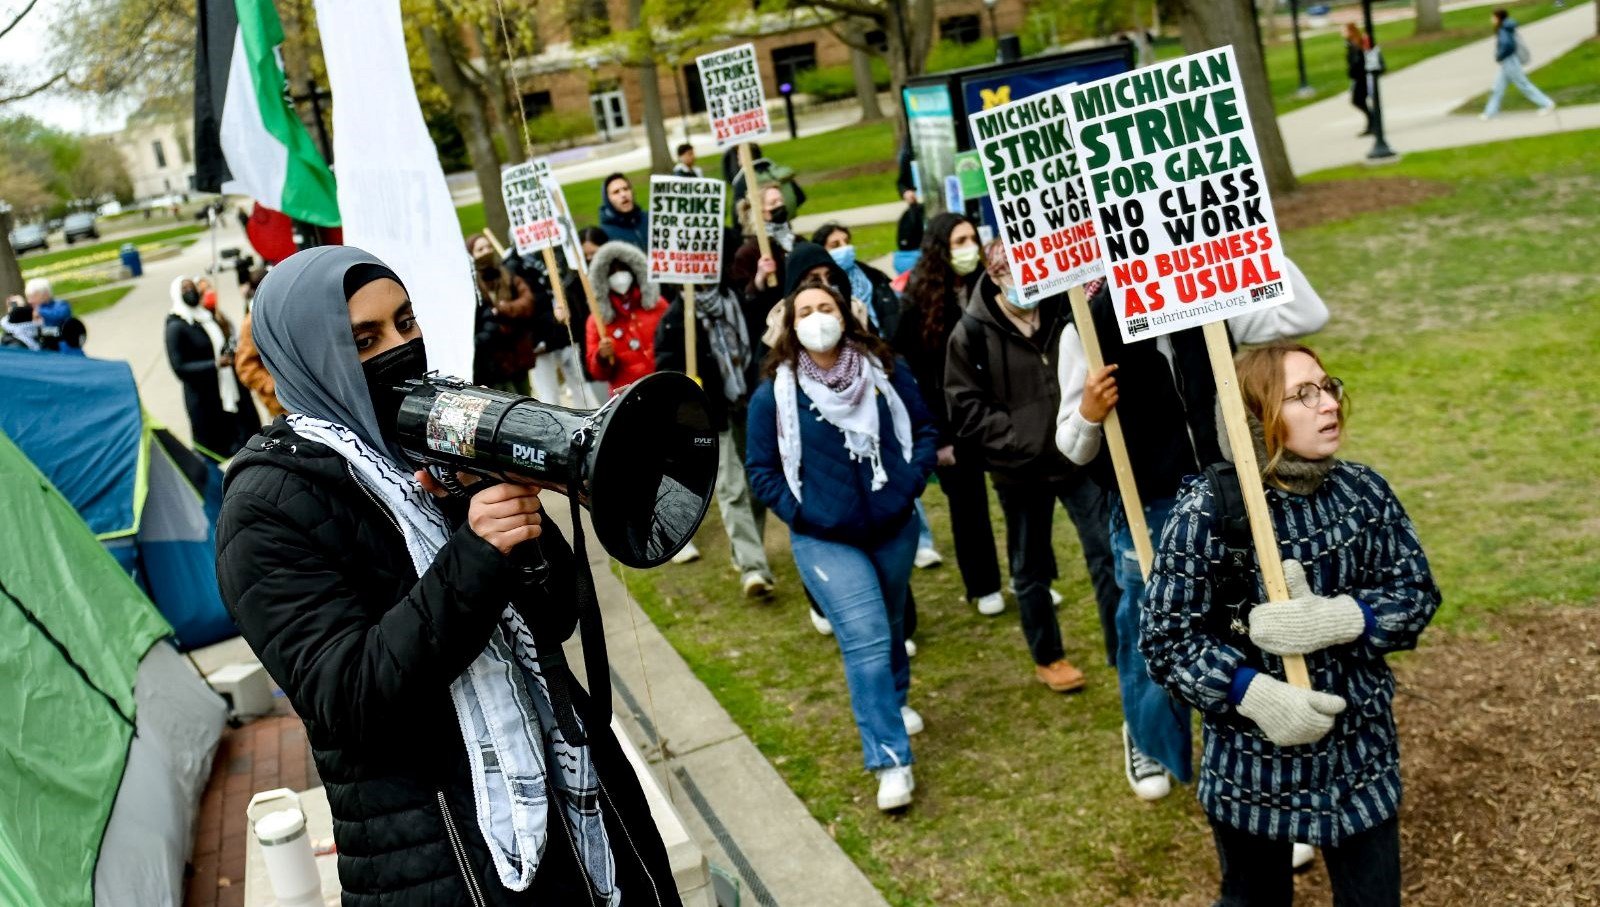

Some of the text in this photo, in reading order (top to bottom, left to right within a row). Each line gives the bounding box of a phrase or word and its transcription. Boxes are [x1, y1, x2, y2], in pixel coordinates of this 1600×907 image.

[702, 48, 752, 68] MICHIGAN
[704, 60, 755, 86] STRIKE
[708, 77, 757, 97] FOR GAZA
[710, 88, 760, 109] NO CLASS
[1070, 52, 1231, 122] MICHIGAN
[713, 108, 725, 118] NO
[975, 94, 1066, 140] MICHIGA
[717, 128, 730, 139] AS
[1080, 87, 1244, 171] STRIKE
[984, 118, 1072, 176] STRIK
[993, 153, 1081, 201] FOR GAZ
[1091, 136, 1252, 204] FOR GAZA
[653, 182, 721, 194] MICHIGAN
[1000, 177, 1087, 224] NO CLAS
[1099, 168, 1259, 235] NO CLASS
[653, 195, 721, 214] STRIKE
[653, 214, 719, 228] FOR GAZA
[653, 228, 719, 240] NO CLASS
[1006, 199, 1092, 245] NO WOR
[1105, 197, 1267, 262] NO WORK
[651, 251, 718, 261] NO BUSINESS
[652, 239, 718, 251] NO WORK
[1012, 220, 1096, 263] NO BUSINE
[1112, 226, 1273, 288] NO BUSINESS
[652, 261, 717, 273] AS USUAL
[1021, 238, 1102, 286] AS USU
[1125, 253, 1281, 318] AS USUAL
[1152, 295, 1247, 326] tahrirumich.org
[513, 443, 545, 465] PYLE
